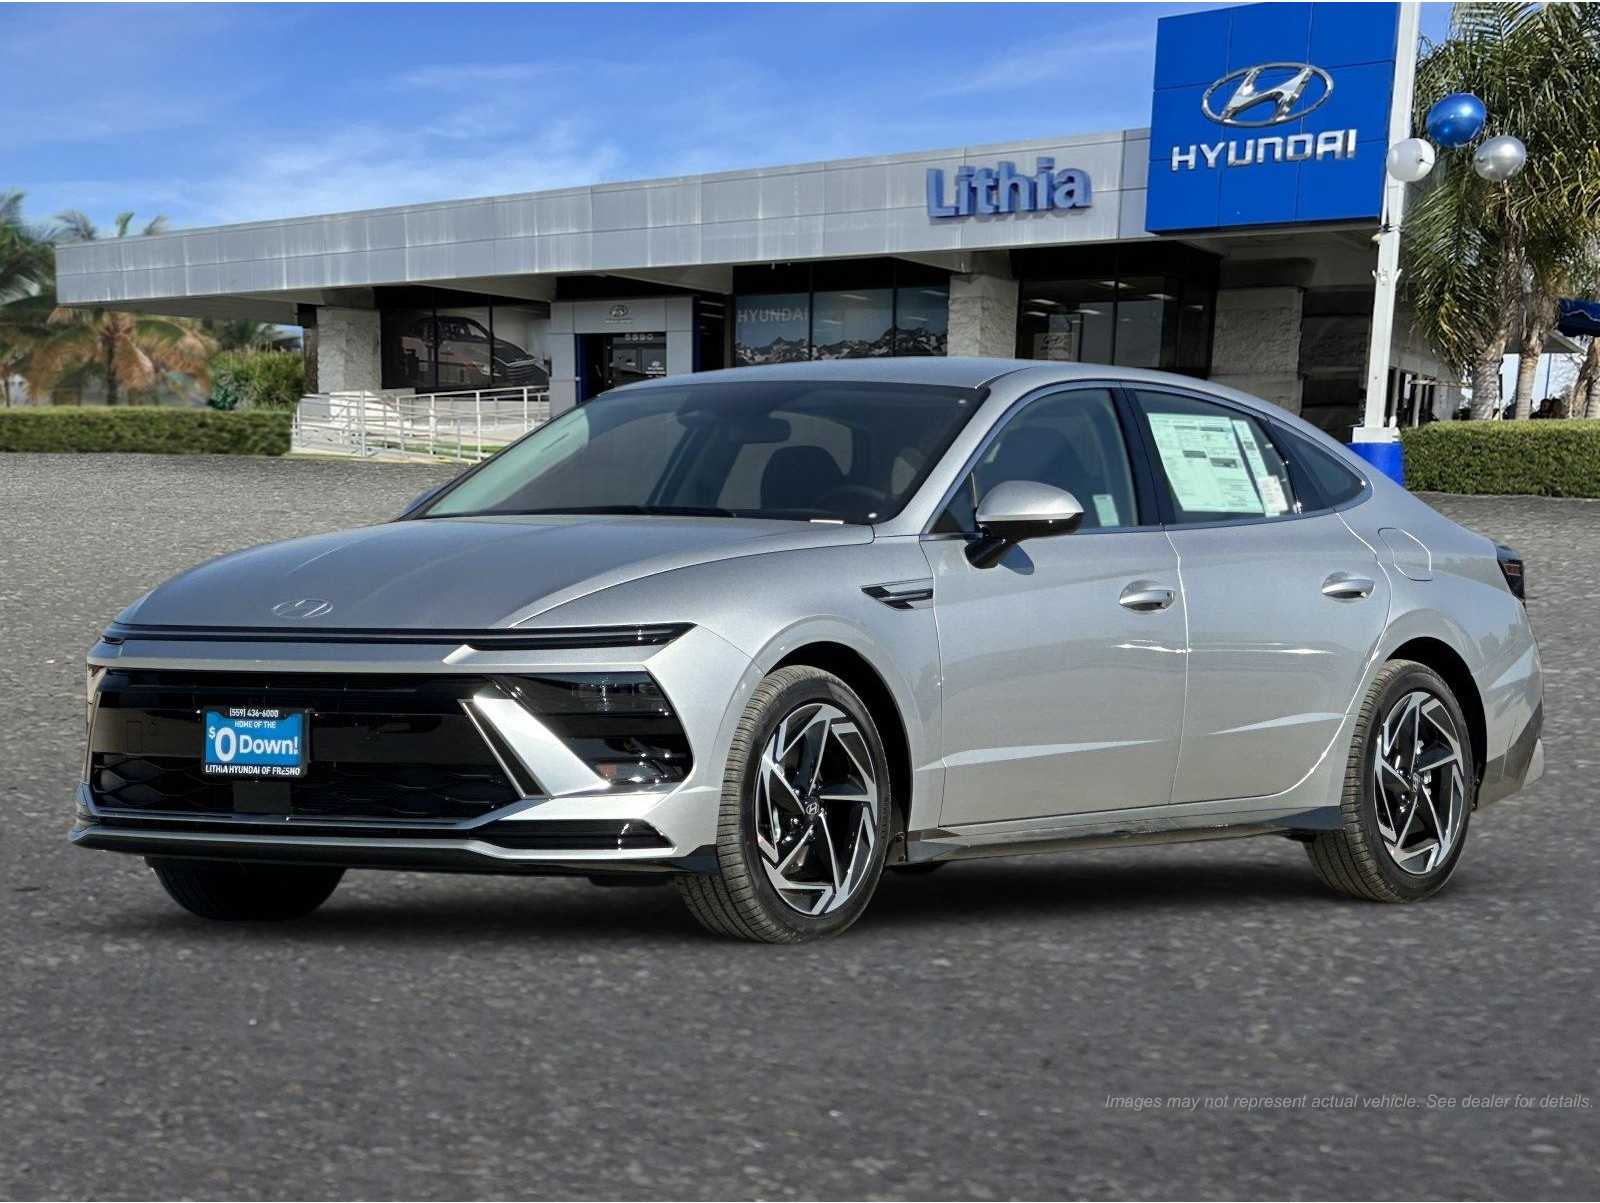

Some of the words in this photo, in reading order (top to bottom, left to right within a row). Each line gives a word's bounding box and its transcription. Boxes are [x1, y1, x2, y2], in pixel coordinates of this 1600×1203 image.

[1171, 129, 1357, 171] HYUNDAI
[926, 157, 1093, 219] Lithia
[737, 307, 808, 322] HYUNDAI
[234, 720, 252, 728] HOME
[253, 720, 263, 728] OF
[264, 720, 277, 728] THE
[239, 735, 298, 755] Down!
[205, 765, 228, 774] LITHIA
[228, 765, 260, 775] HYUNDAI
[261, 766, 271, 775] OF
